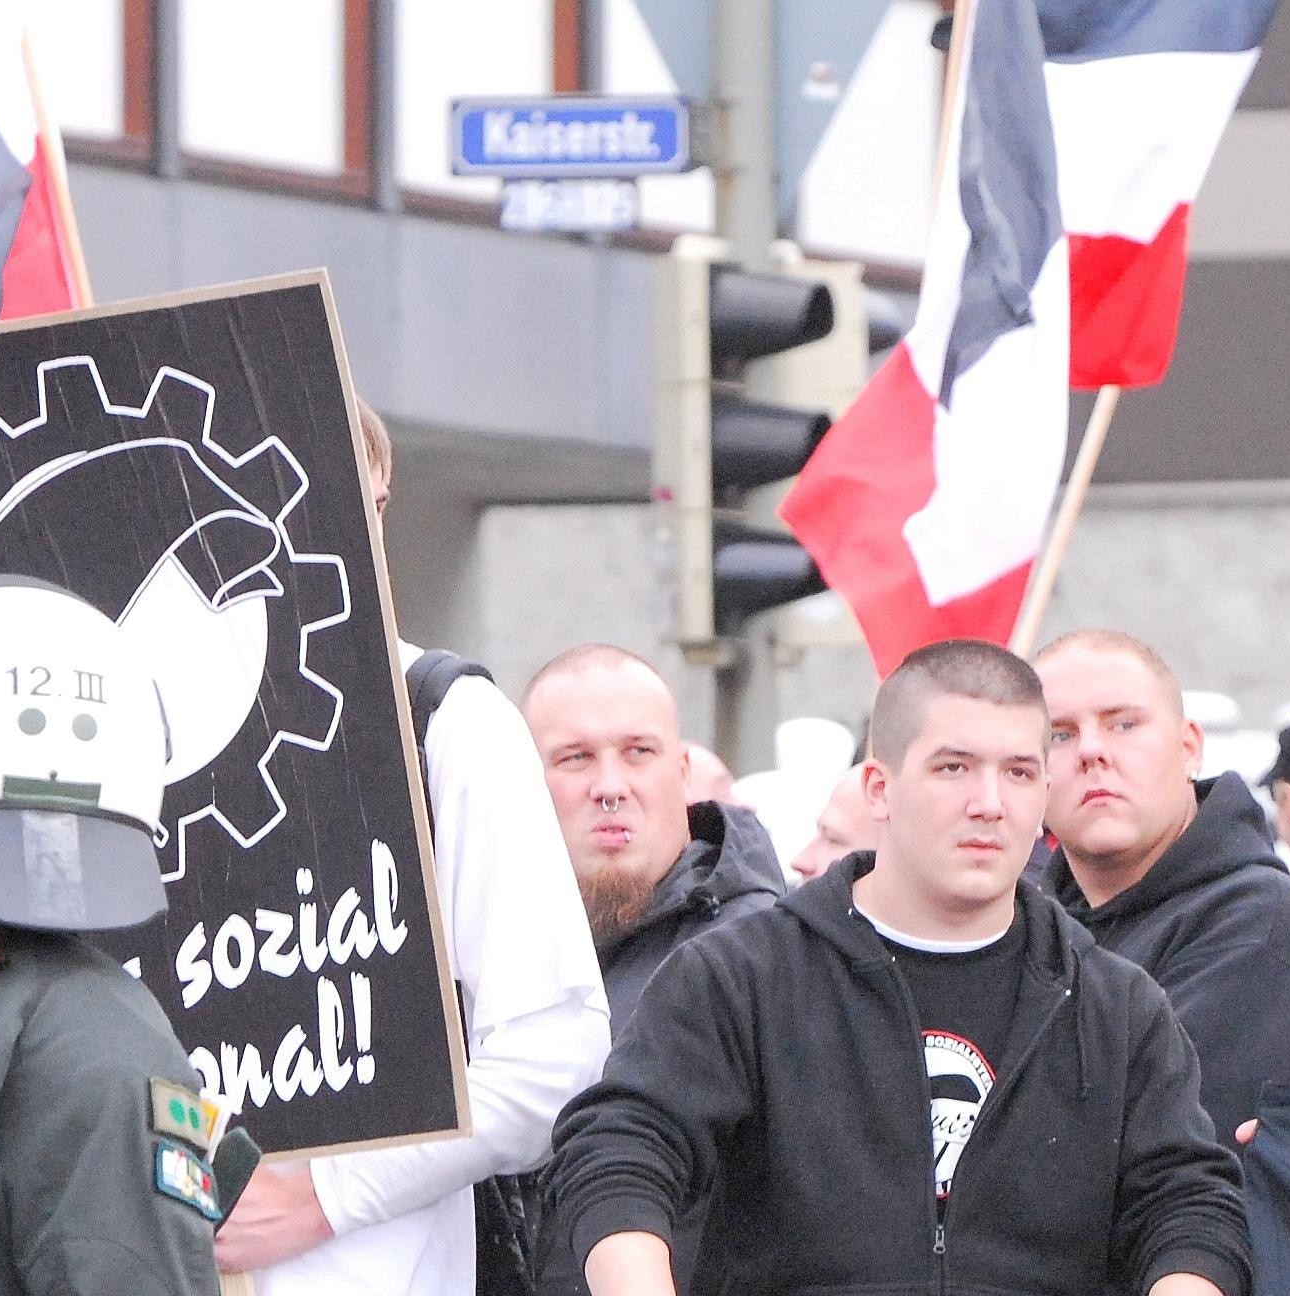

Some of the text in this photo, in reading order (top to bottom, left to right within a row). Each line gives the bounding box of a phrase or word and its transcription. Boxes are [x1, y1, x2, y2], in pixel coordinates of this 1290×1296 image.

[482, 110, 661, 160] Kaiserstr.
[175, 838, 409, 1009] sozial
[187, 970, 376, 1115] onal!
